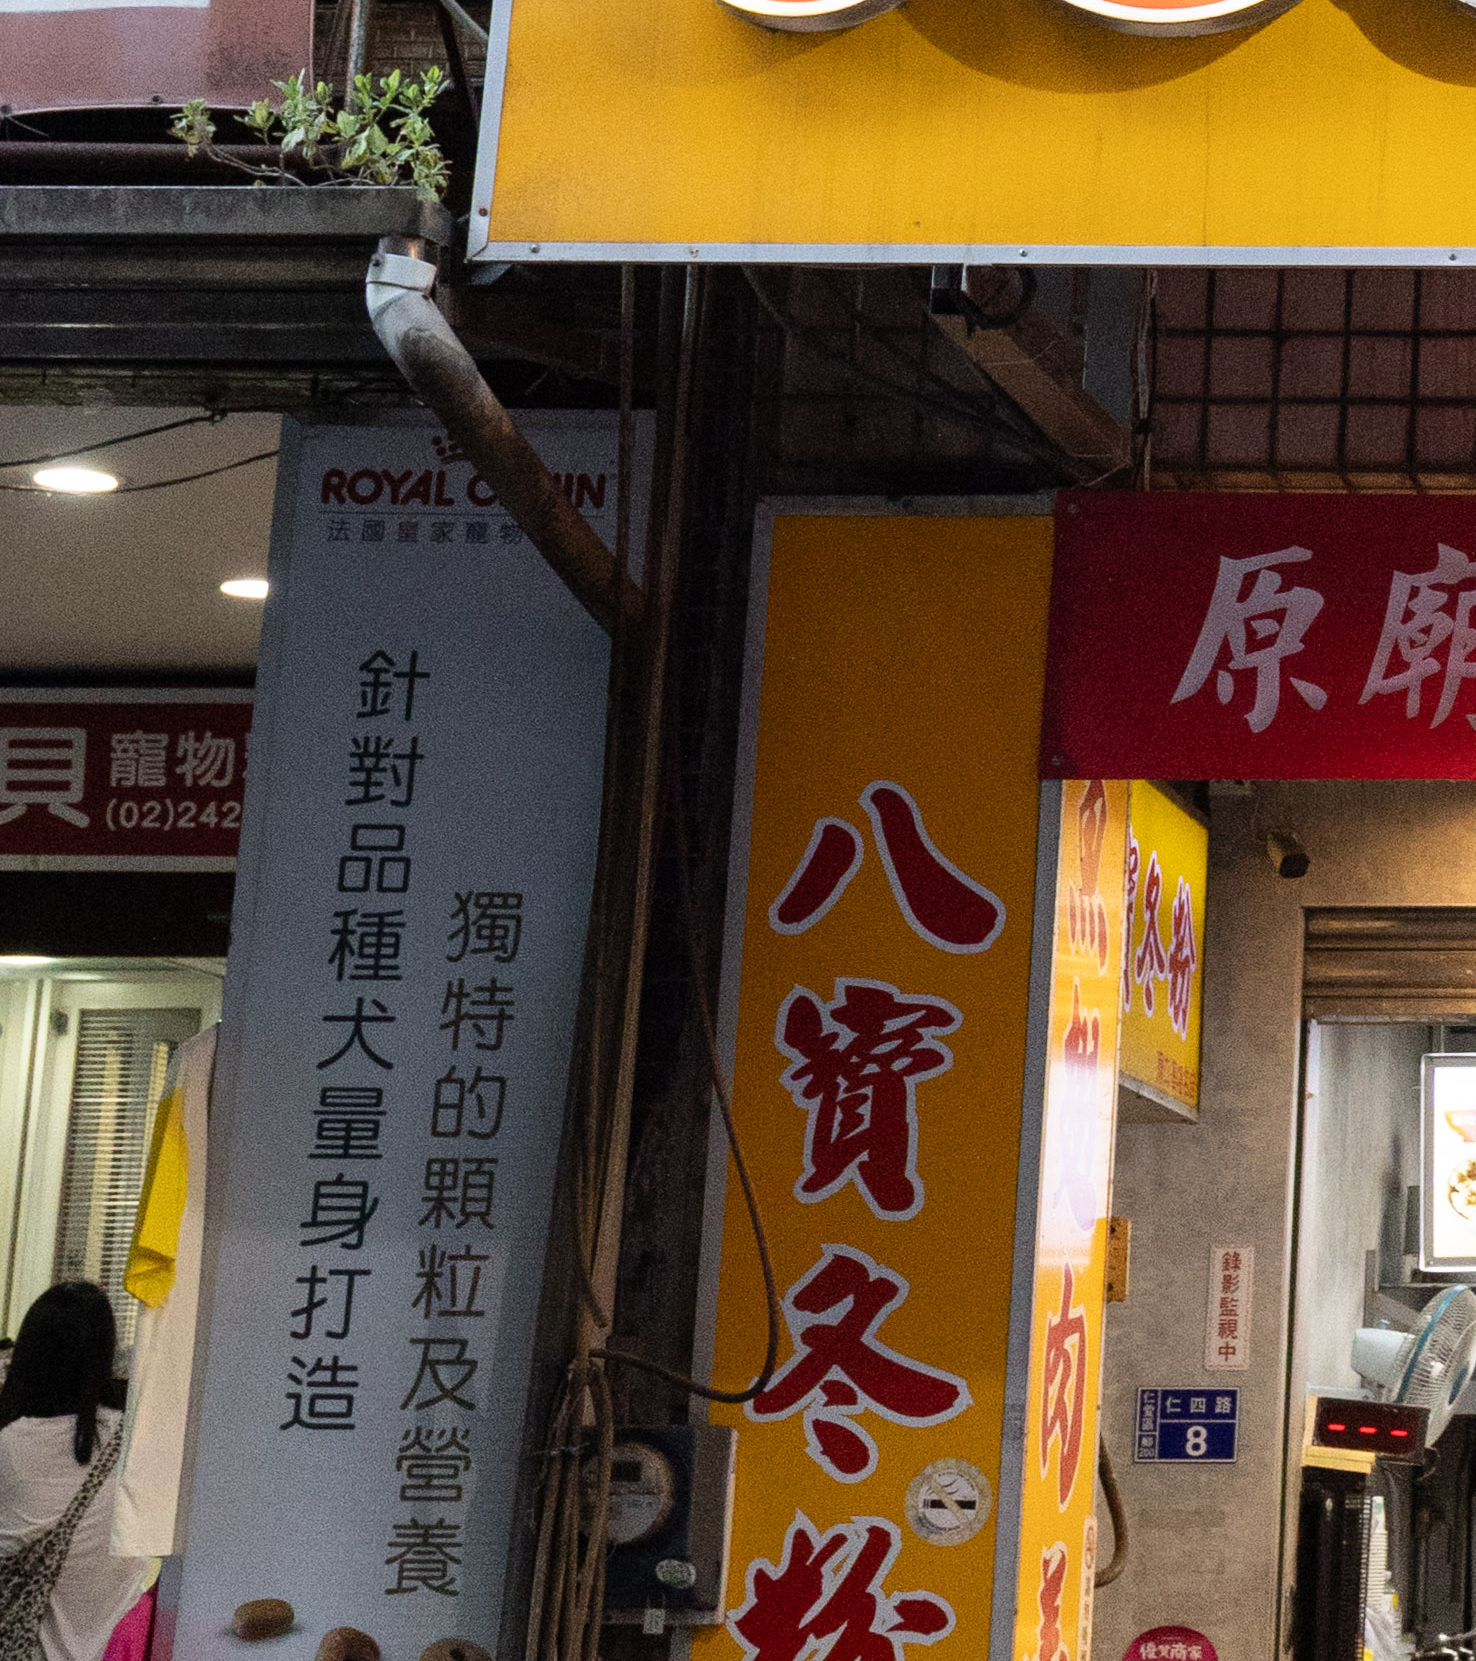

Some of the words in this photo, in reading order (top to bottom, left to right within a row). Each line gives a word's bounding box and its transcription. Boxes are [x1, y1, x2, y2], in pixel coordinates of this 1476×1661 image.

[320, 468, 455, 507] ROYAL
[466, 471, 607, 509] CIN
[109, 730, 248, 789] 寵物
[280, 649, 431, 1433] 針對品種犬量身打造
[384, 889, 524, 1599] 獨特的顆粒及營養
[1217, 1250, 1242, 1363] 錄影監視中
[1165, 1396, 1232, 1415] 仁四路
[1184, 1425, 1208, 1457] 8
